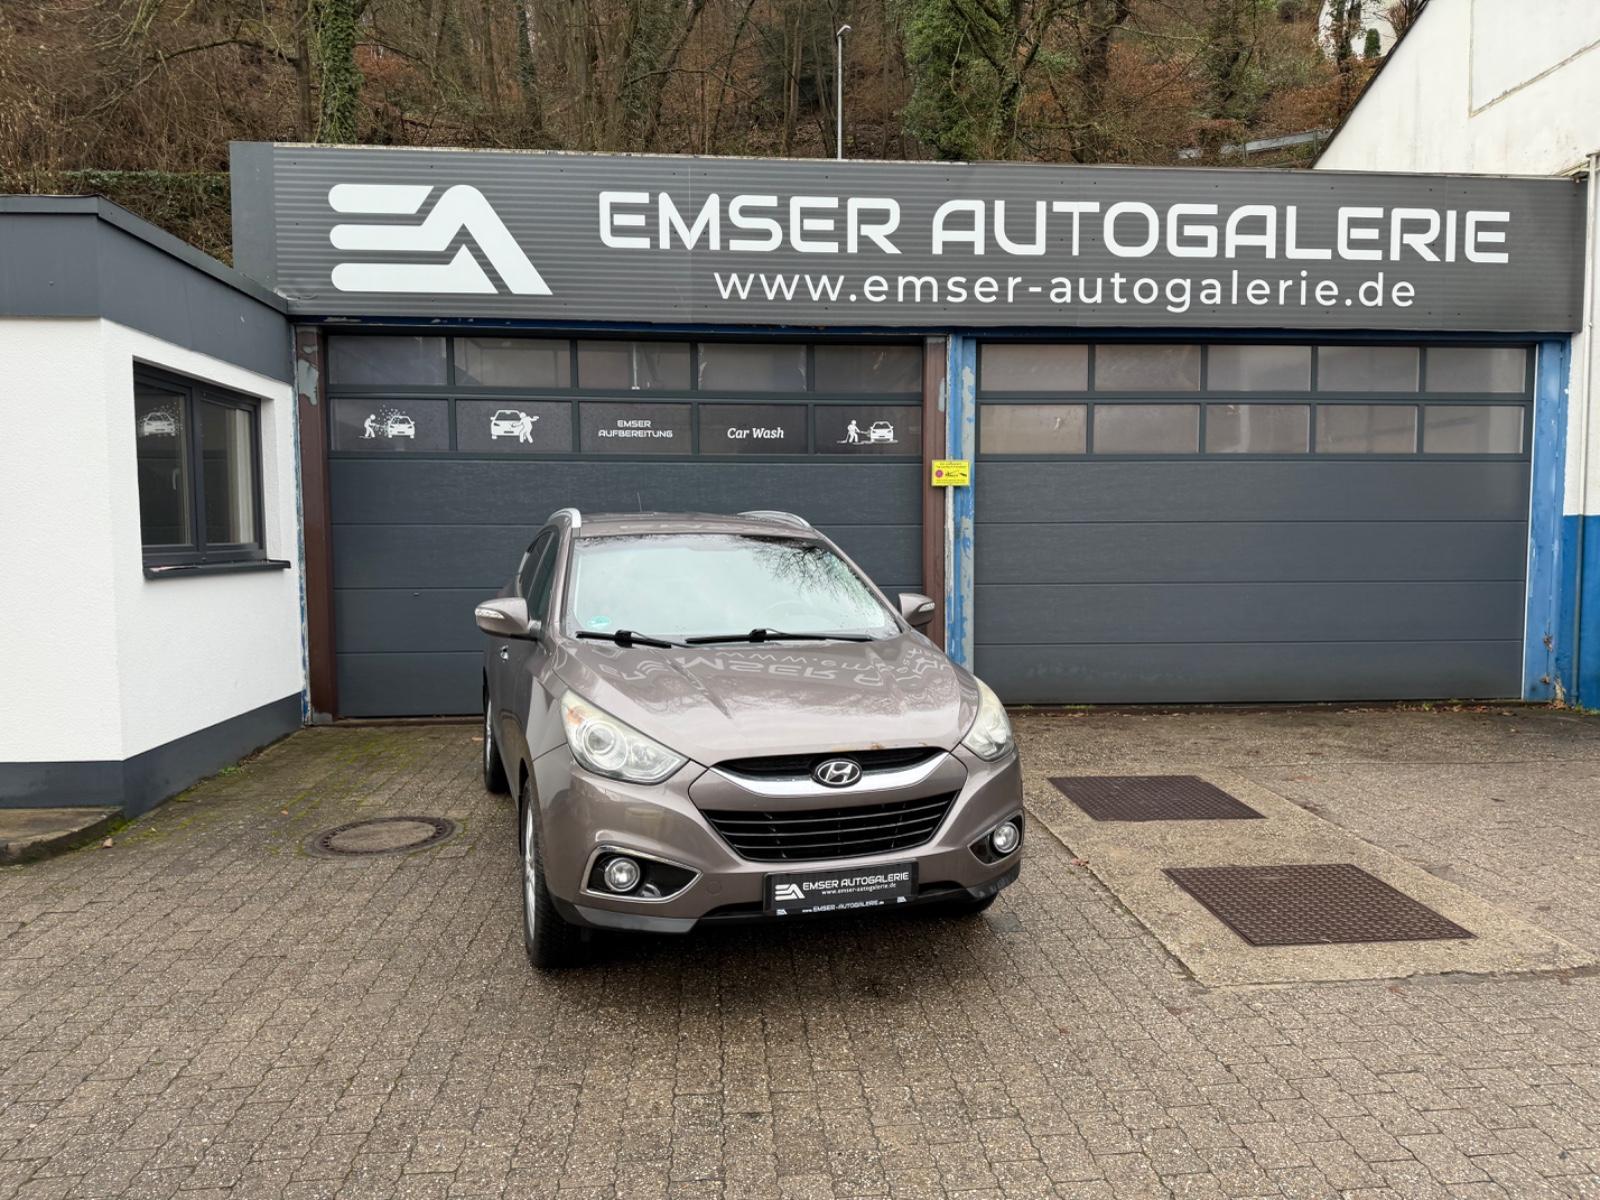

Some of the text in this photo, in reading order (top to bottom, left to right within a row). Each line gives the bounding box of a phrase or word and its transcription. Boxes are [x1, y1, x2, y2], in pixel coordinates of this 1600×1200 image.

[598, 190, 1511, 264] EMSER AUTOGALERIE
[713, 270, 1416, 314] www.emser-autogalerie.de
[617, 420, 652, 428] EMSER
[598, 429, 674, 438] AUFBEREITUNG
[727, 427, 785, 439] Car Wash
[802, 872, 909, 891] EMSER AUTOGALERIE
